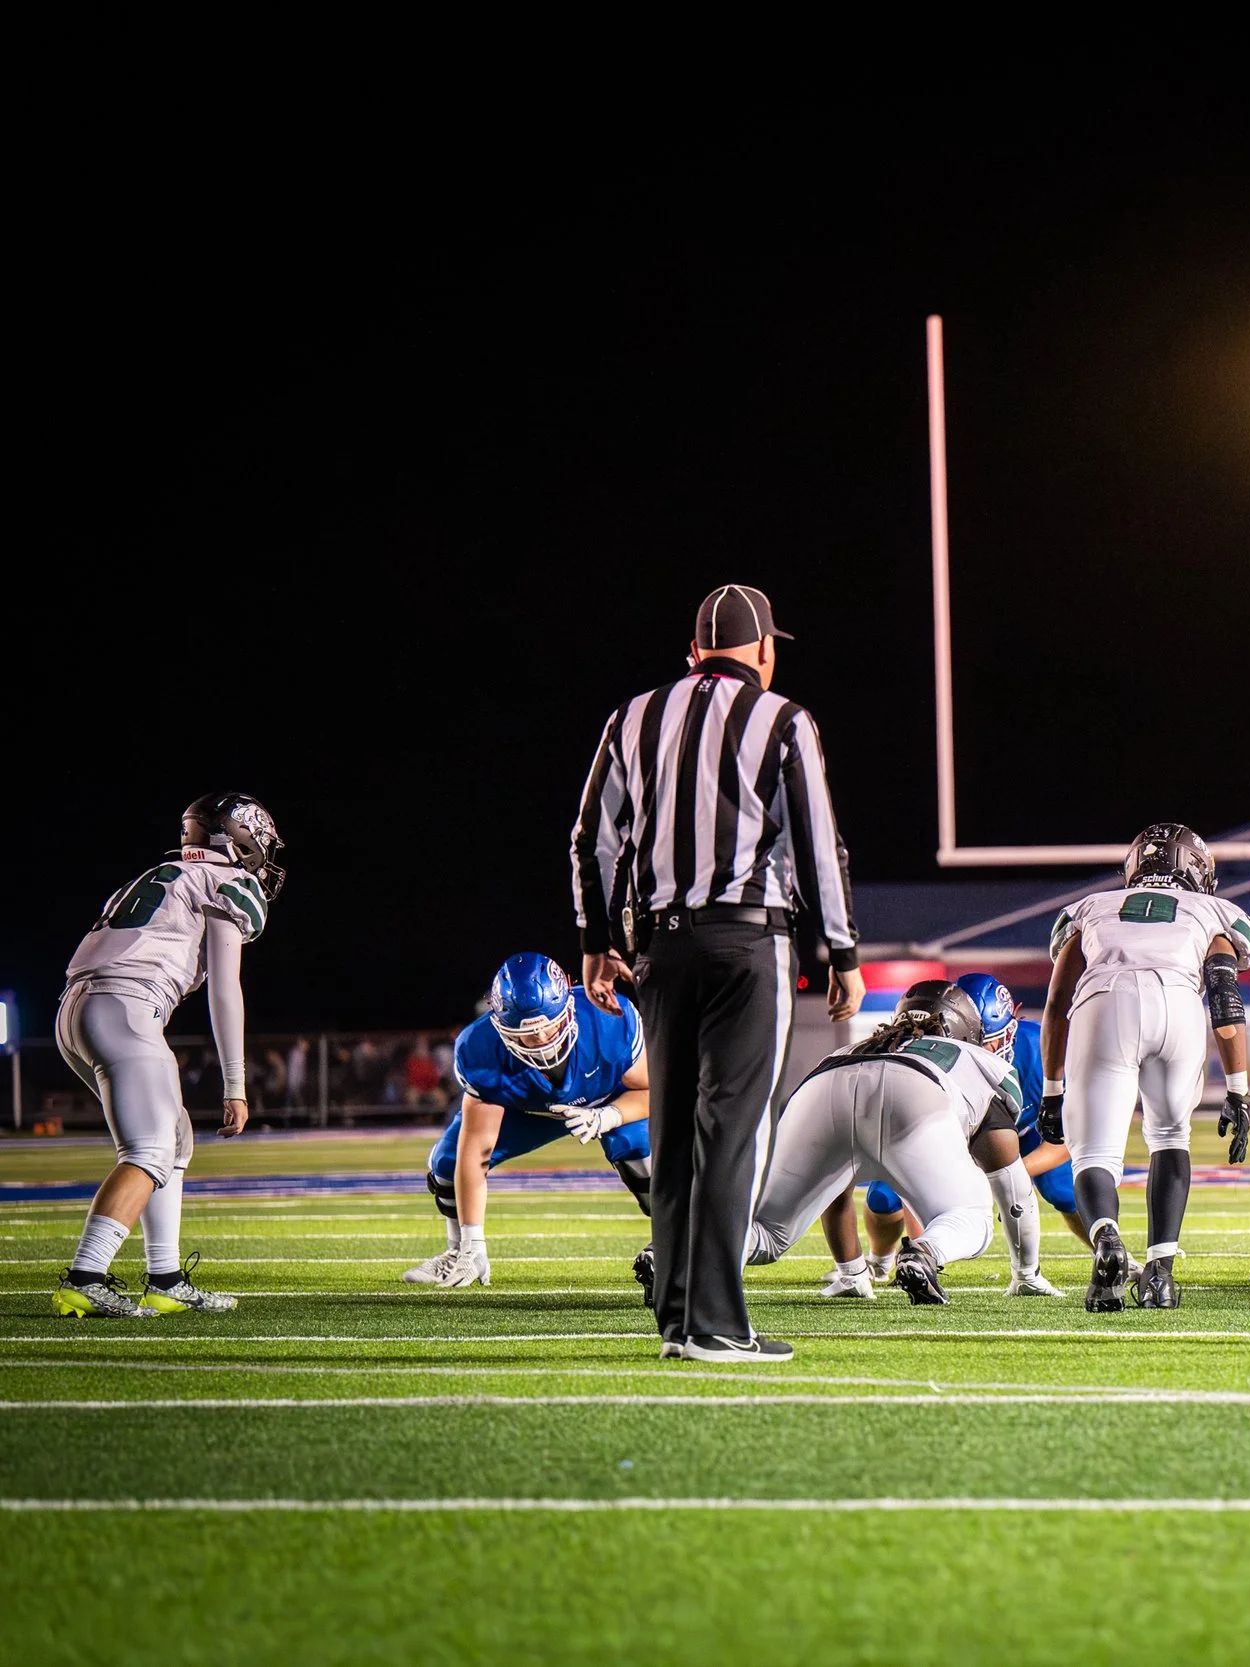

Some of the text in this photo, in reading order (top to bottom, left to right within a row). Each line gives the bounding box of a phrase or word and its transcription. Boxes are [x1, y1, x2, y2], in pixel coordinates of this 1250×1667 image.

[1142, 873, 1174, 882] schutt
[1118, 891, 1179, 923] 0
[668, 915, 679, 930] S
